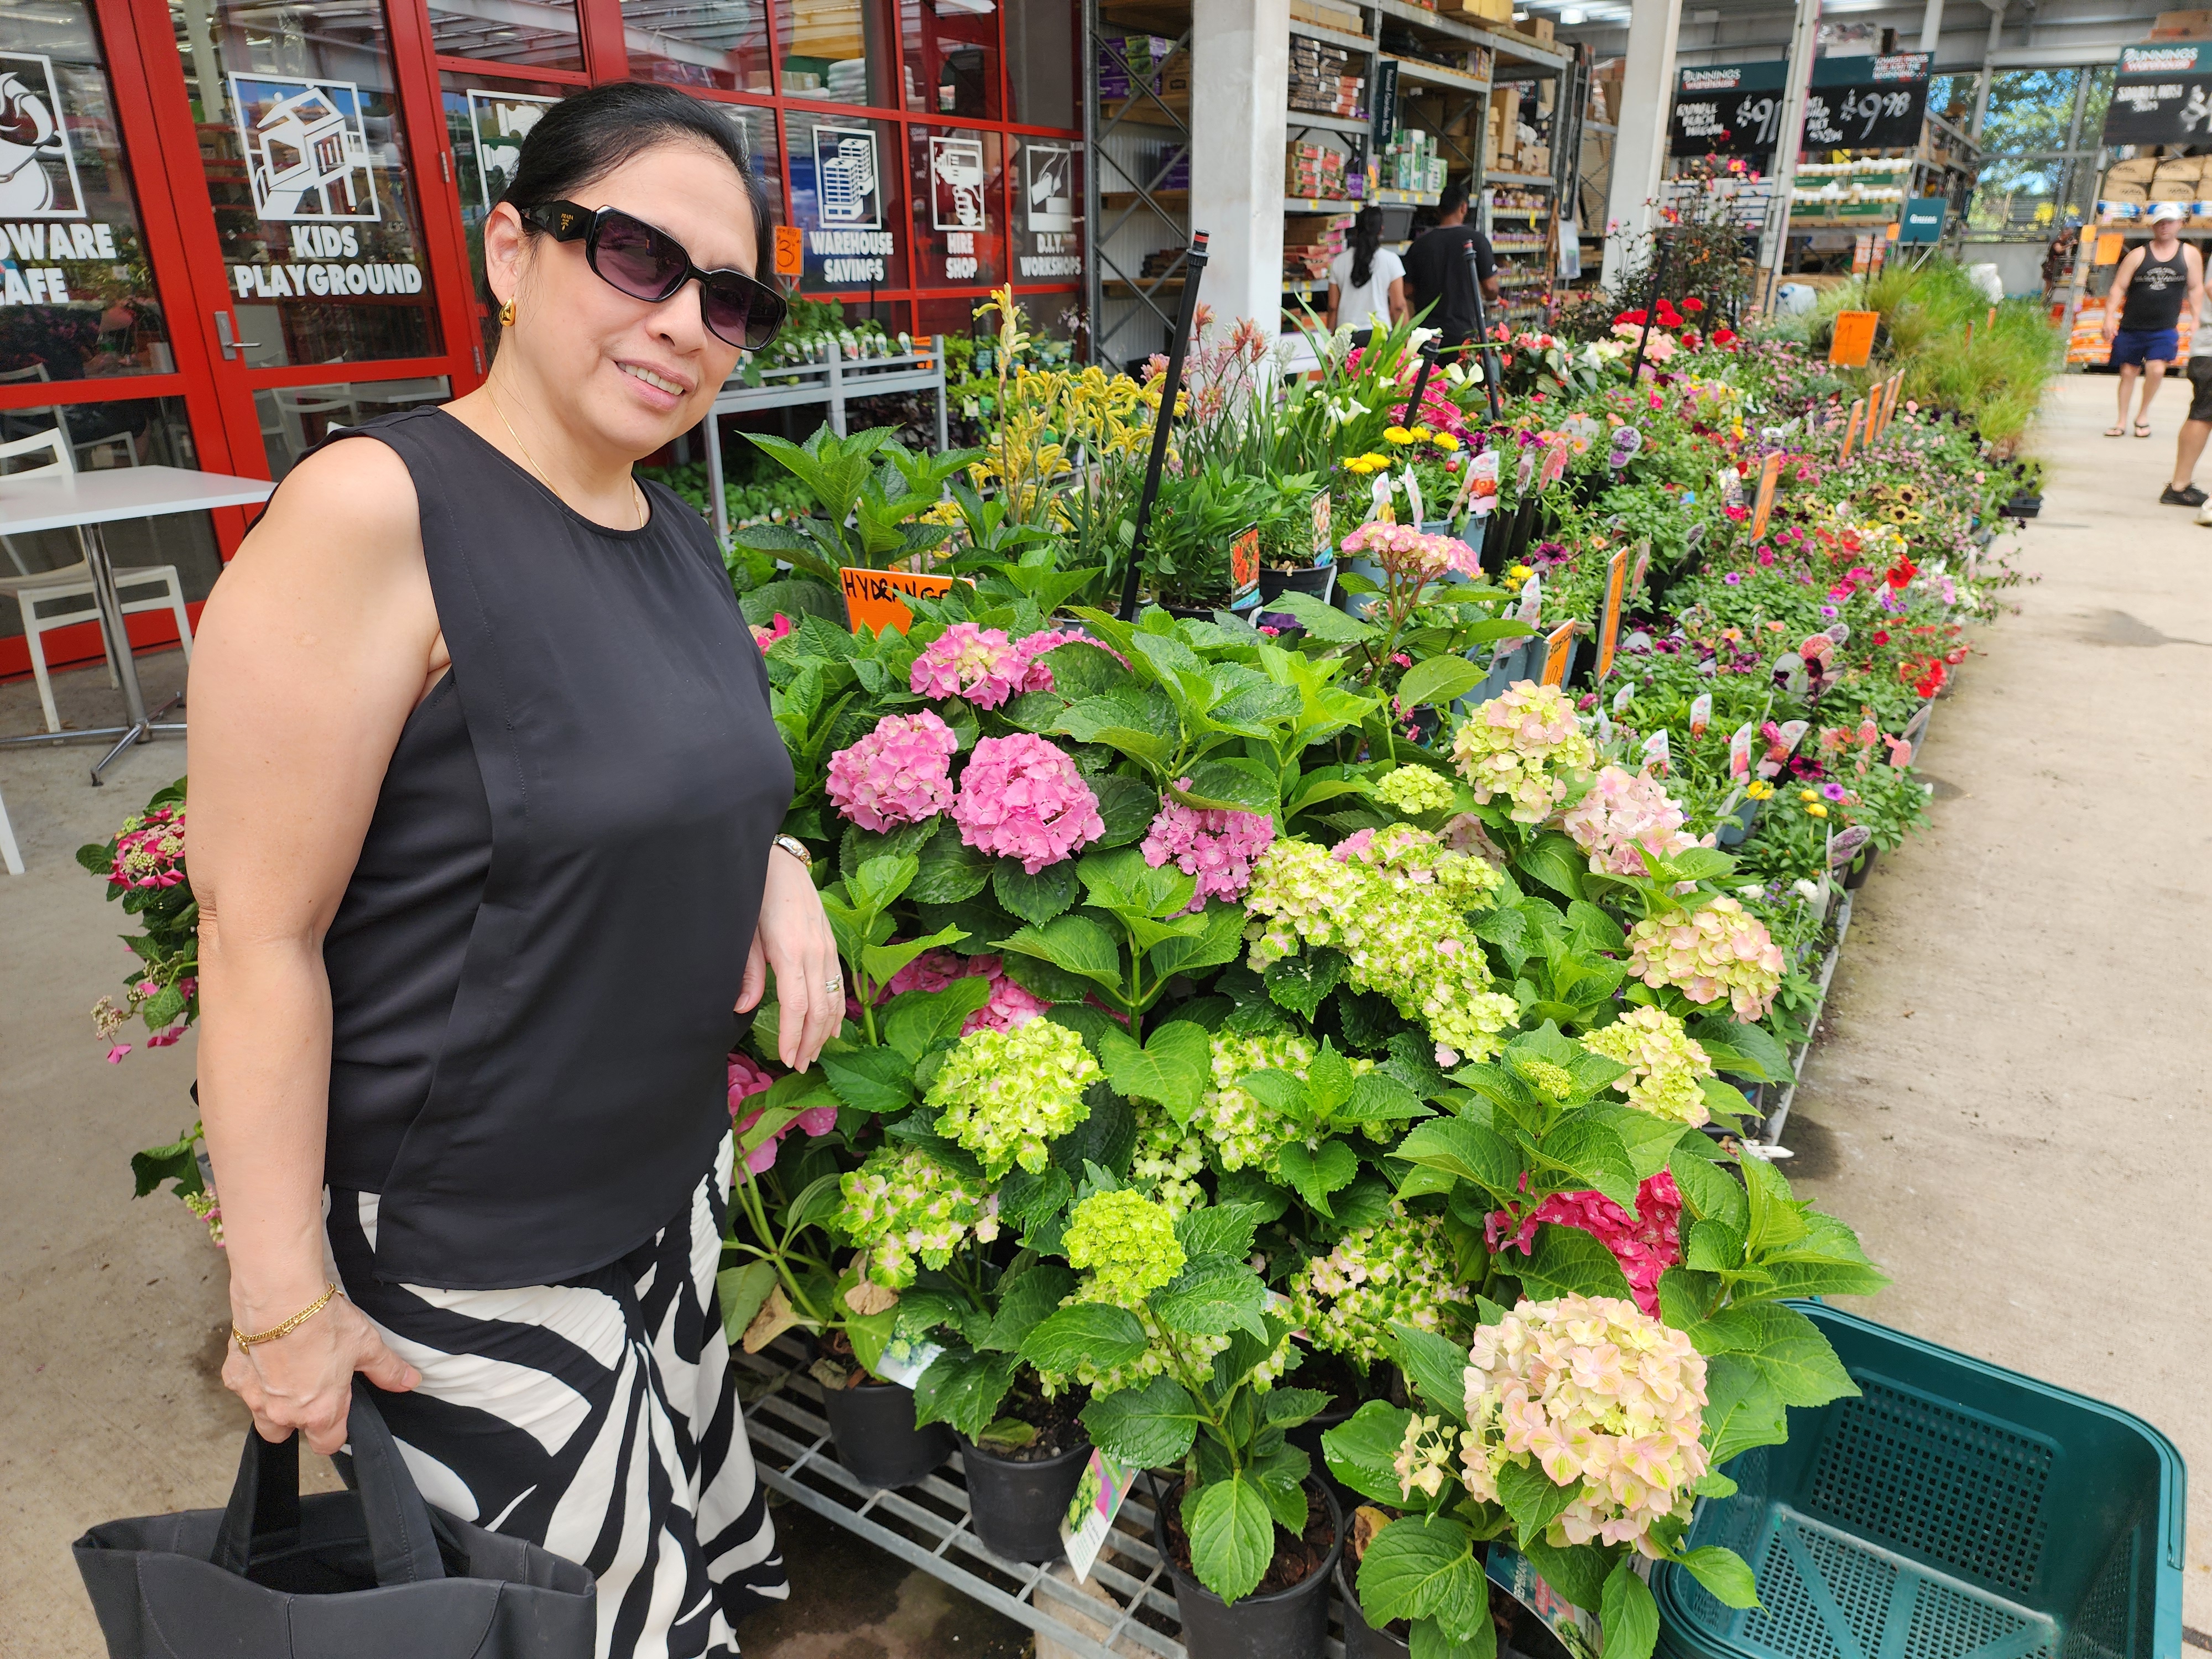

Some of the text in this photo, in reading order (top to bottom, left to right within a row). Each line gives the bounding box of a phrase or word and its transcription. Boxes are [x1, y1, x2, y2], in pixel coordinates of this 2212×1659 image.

[2124, 48, 2199, 62] BUNNINGS
[1683, 69, 1741, 82] BUNNINGS
[290, 225, 359, 258] KIDS
[808, 231, 894, 255] WAREHOUSE
[946, 232, 975, 254] HIRE
[945, 257, 978, 279] SHOP
[1019, 255, 1082, 277] WORKSHOPS
[0, 268, 70, 305] AFE
[233, 263, 422, 298] PLAYGROUND
